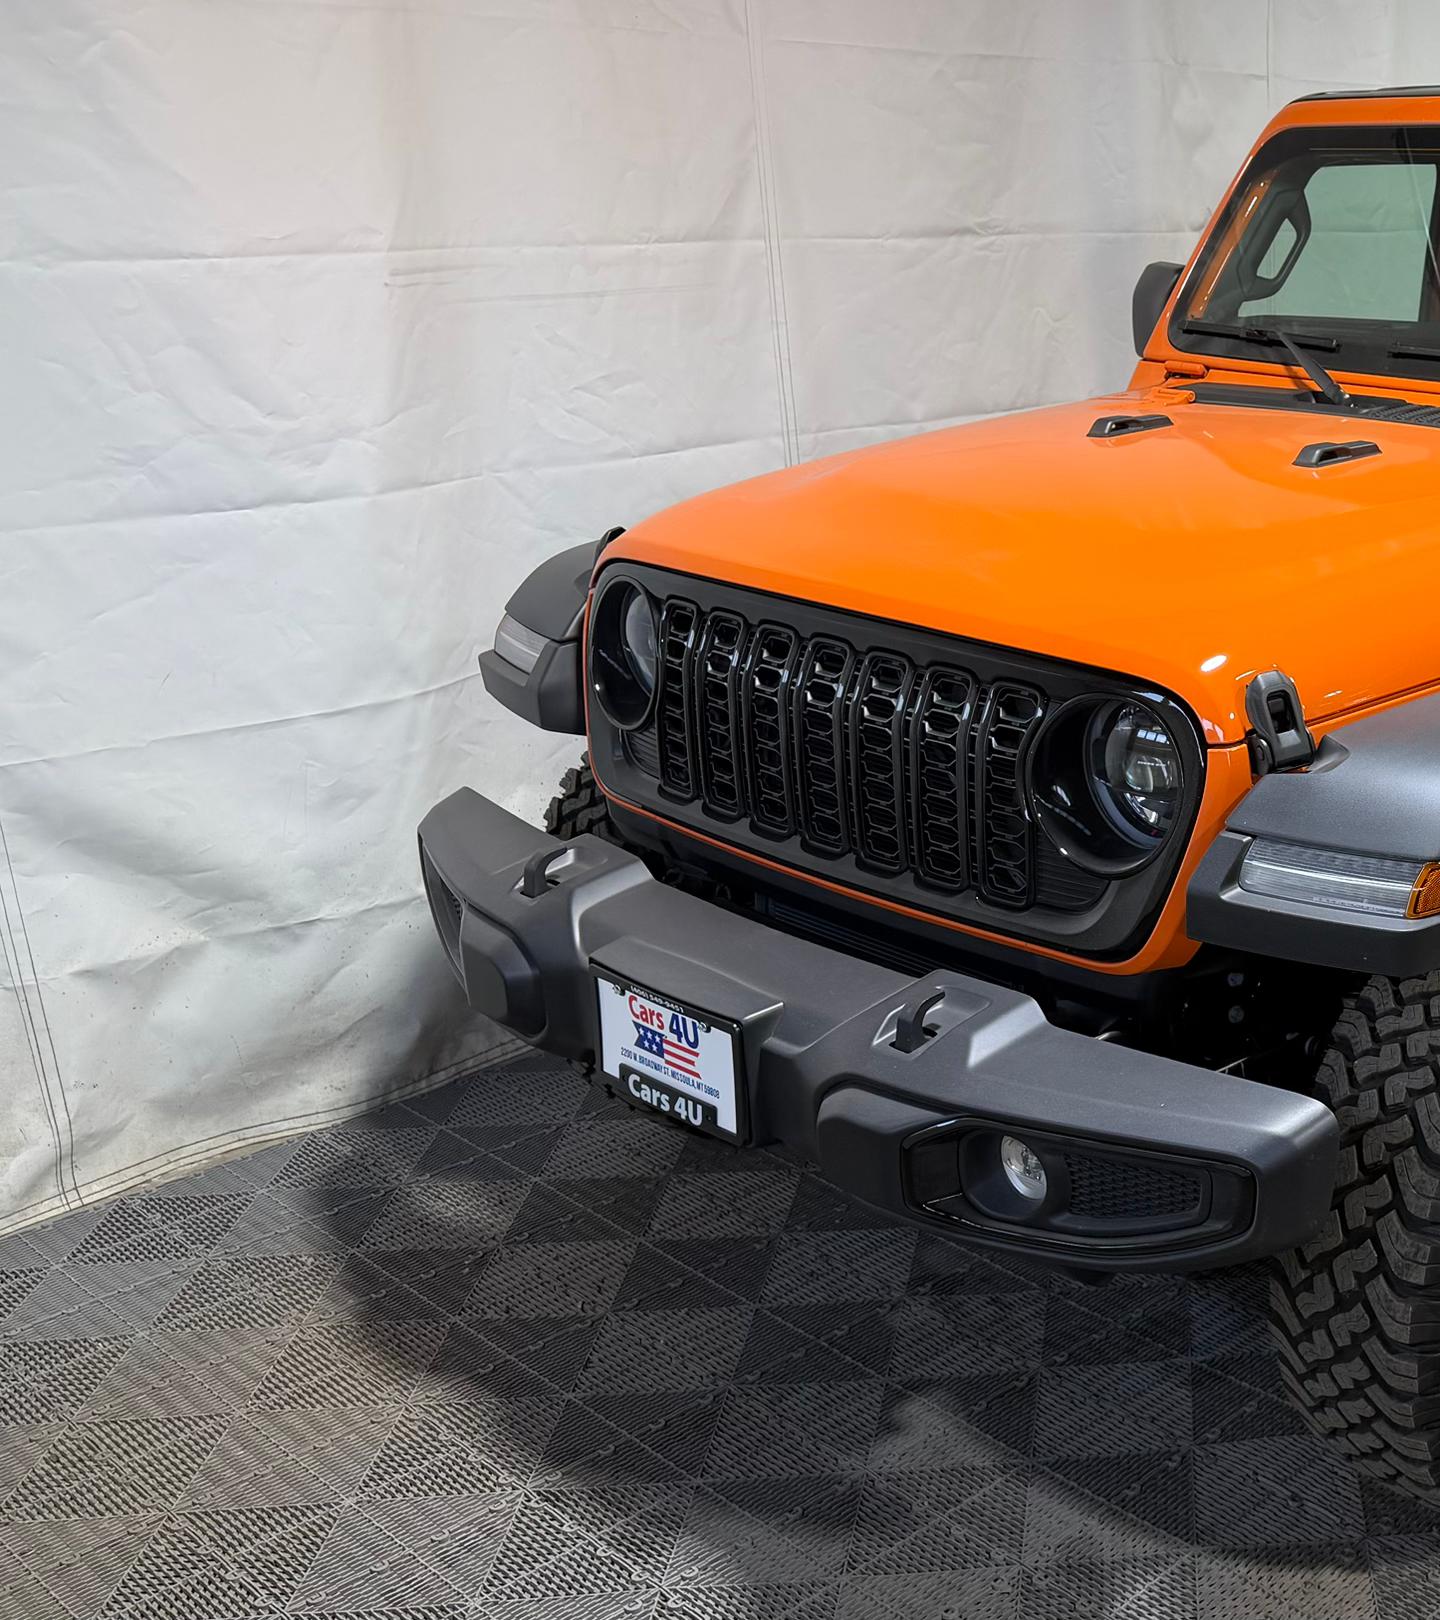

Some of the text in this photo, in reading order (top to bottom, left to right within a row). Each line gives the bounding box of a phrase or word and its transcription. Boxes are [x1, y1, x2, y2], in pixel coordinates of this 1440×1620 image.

[628, 994, 700, 1049] Cars 4U
[628, 1073, 703, 1127] Cars 4U
